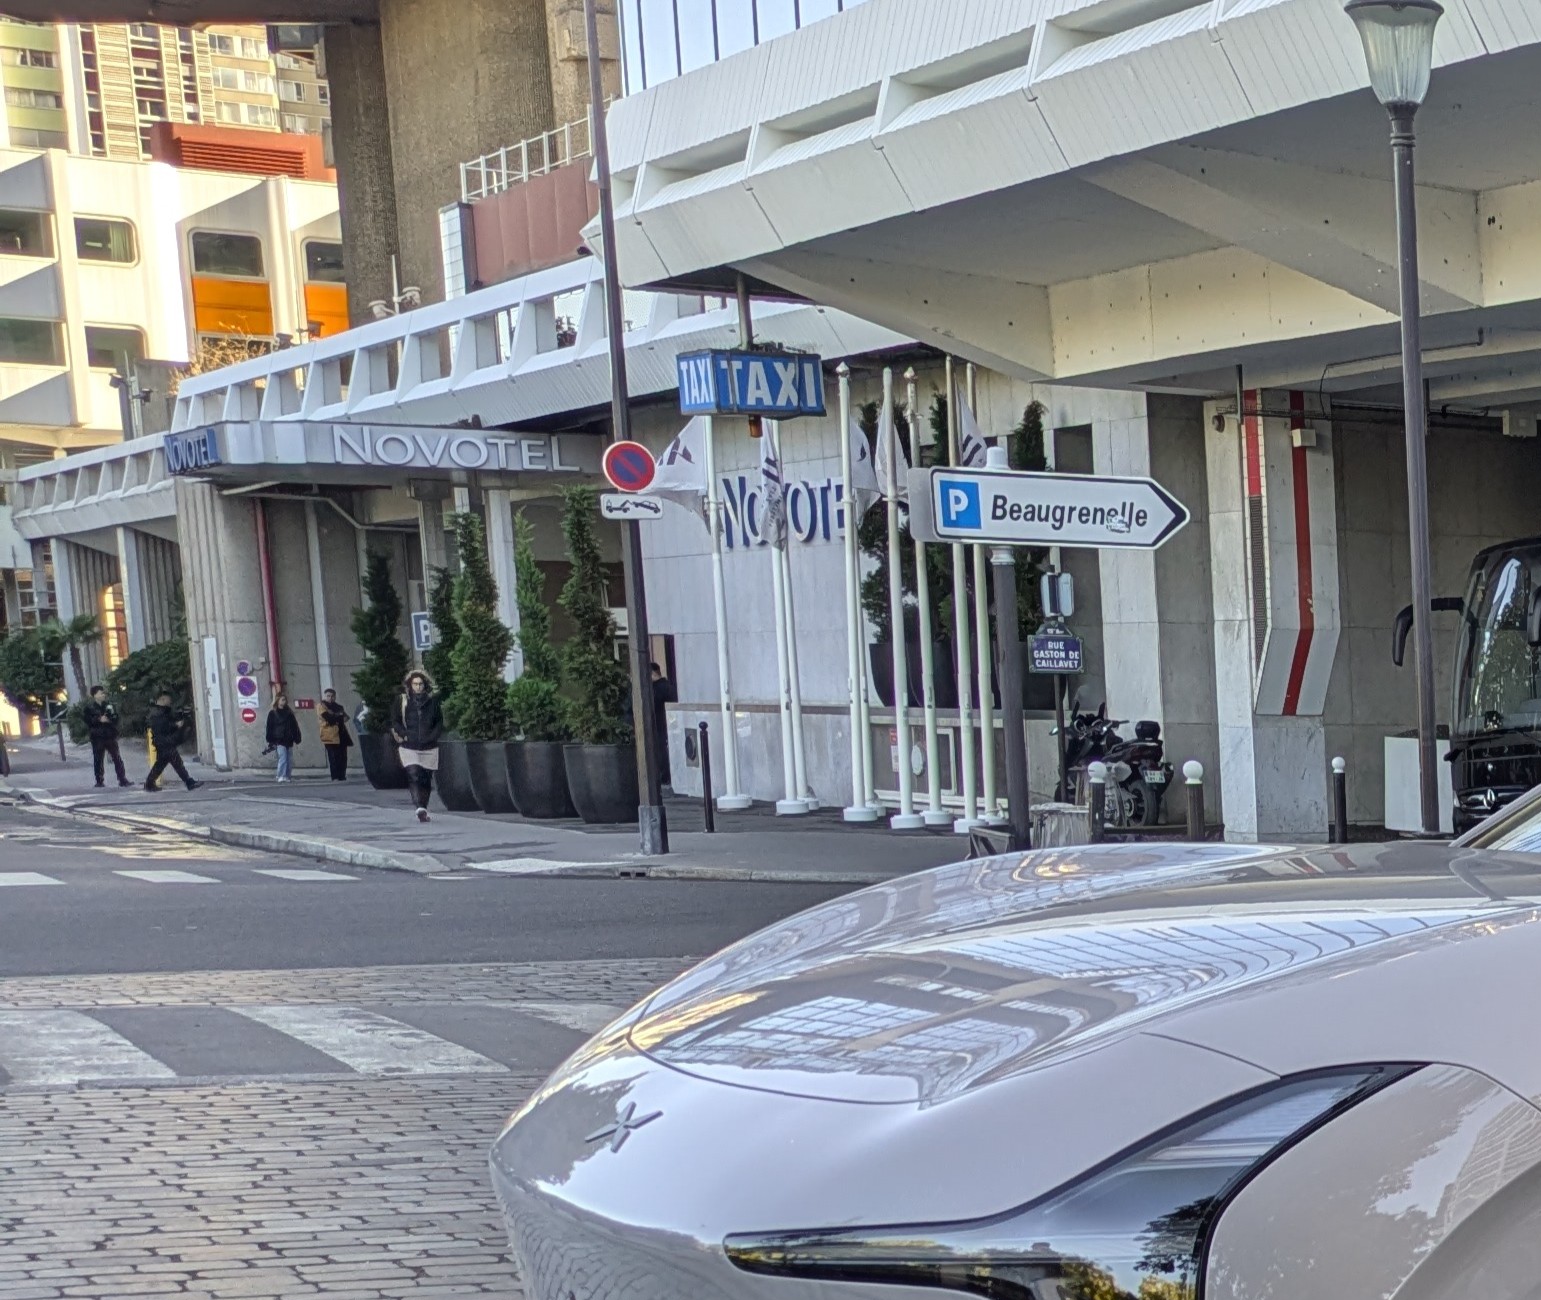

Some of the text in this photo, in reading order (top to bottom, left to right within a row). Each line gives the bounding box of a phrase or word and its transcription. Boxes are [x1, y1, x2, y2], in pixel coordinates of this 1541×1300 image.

[680, 358, 714, 406] TAXI
[720, 360, 818, 408] TAXI
[164, 429, 215, 472] NOVOTEL
[332, 425, 581, 472] NOVOTEL
[949, 488, 1148, 531] P Beaugrenelle
[1033, 650, 1080, 660] GASTON DE
[1035, 659, 1079, 669] CAILLAVET
[1047, 641, 1065, 650] RUE
